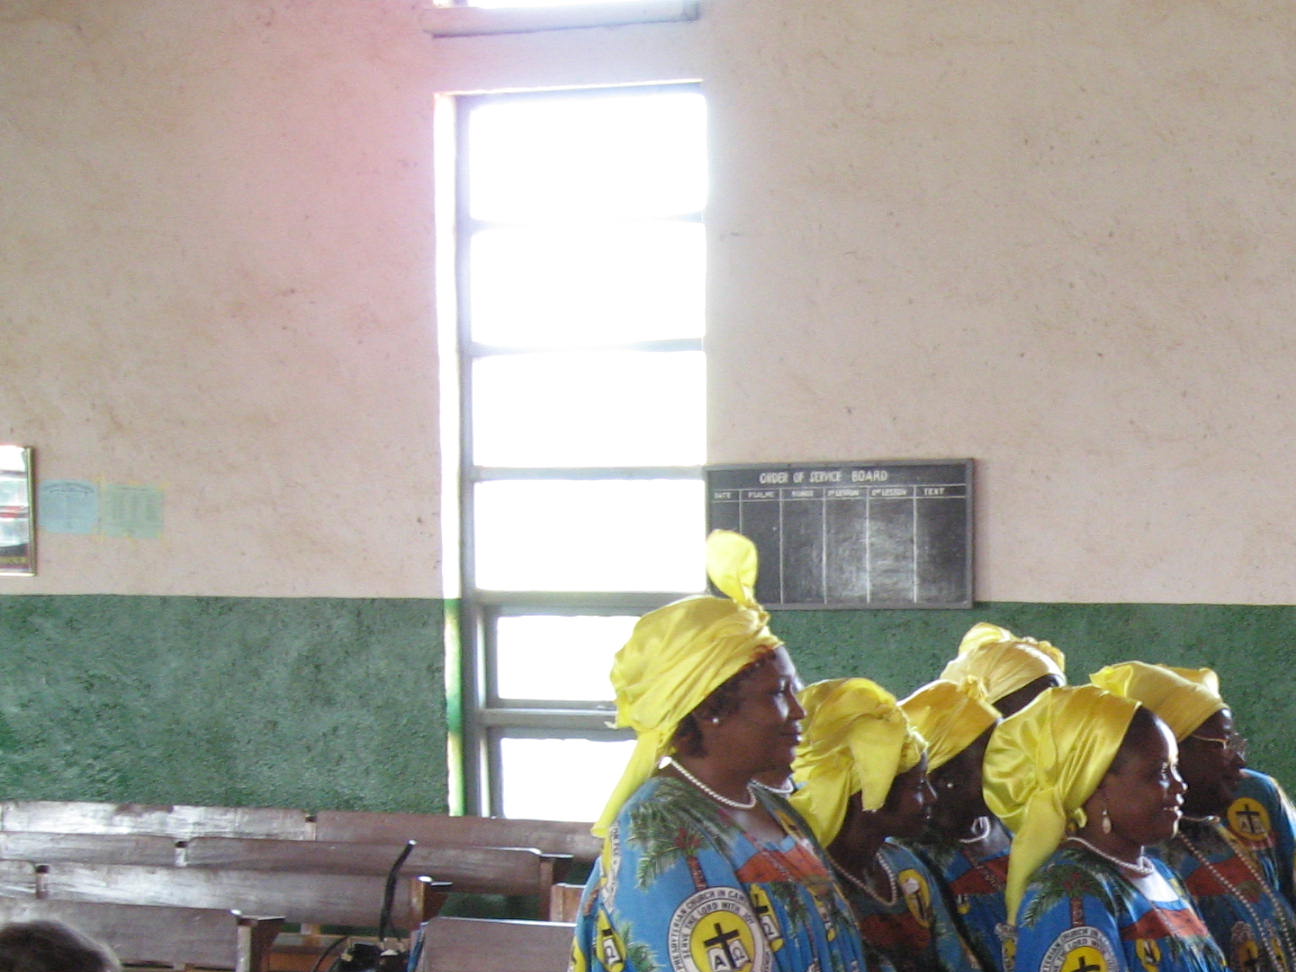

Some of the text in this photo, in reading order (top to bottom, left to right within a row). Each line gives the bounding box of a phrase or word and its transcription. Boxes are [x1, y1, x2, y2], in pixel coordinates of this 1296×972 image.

[759, 469, 888, 485] ORDER OF SERVICE BOARD
[923, 486, 946, 496] TEXT
[685, 890, 716, 910] CHURCH
[681, 933, 691, 959] SERVE
[697, 902, 719, 917] LORD
[721, 901, 741, 913] WITH
